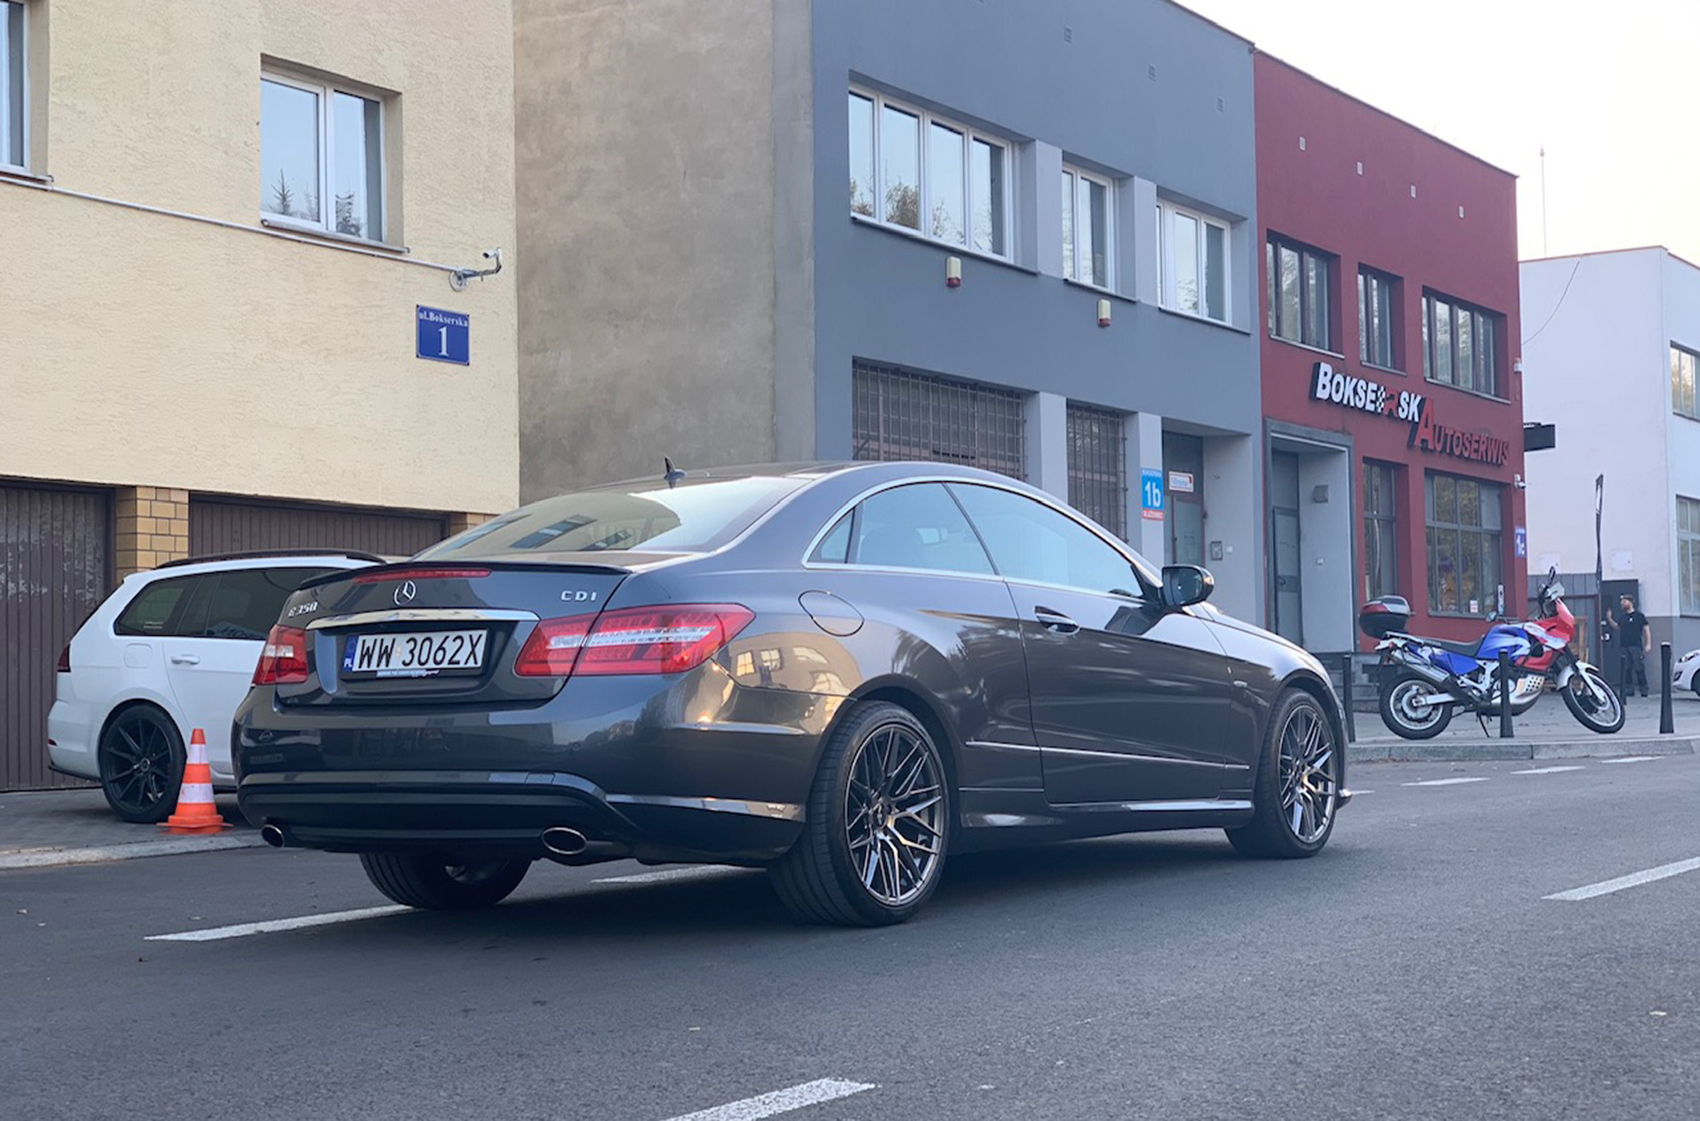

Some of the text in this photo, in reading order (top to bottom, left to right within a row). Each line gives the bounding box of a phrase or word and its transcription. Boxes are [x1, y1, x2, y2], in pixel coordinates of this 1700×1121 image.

[438, 326, 449, 357] 1
[1144, 481, 1161, 508] 1b
[560, 590, 597, 601] CDI
[344, 634, 482, 669] PL WW 3062X
